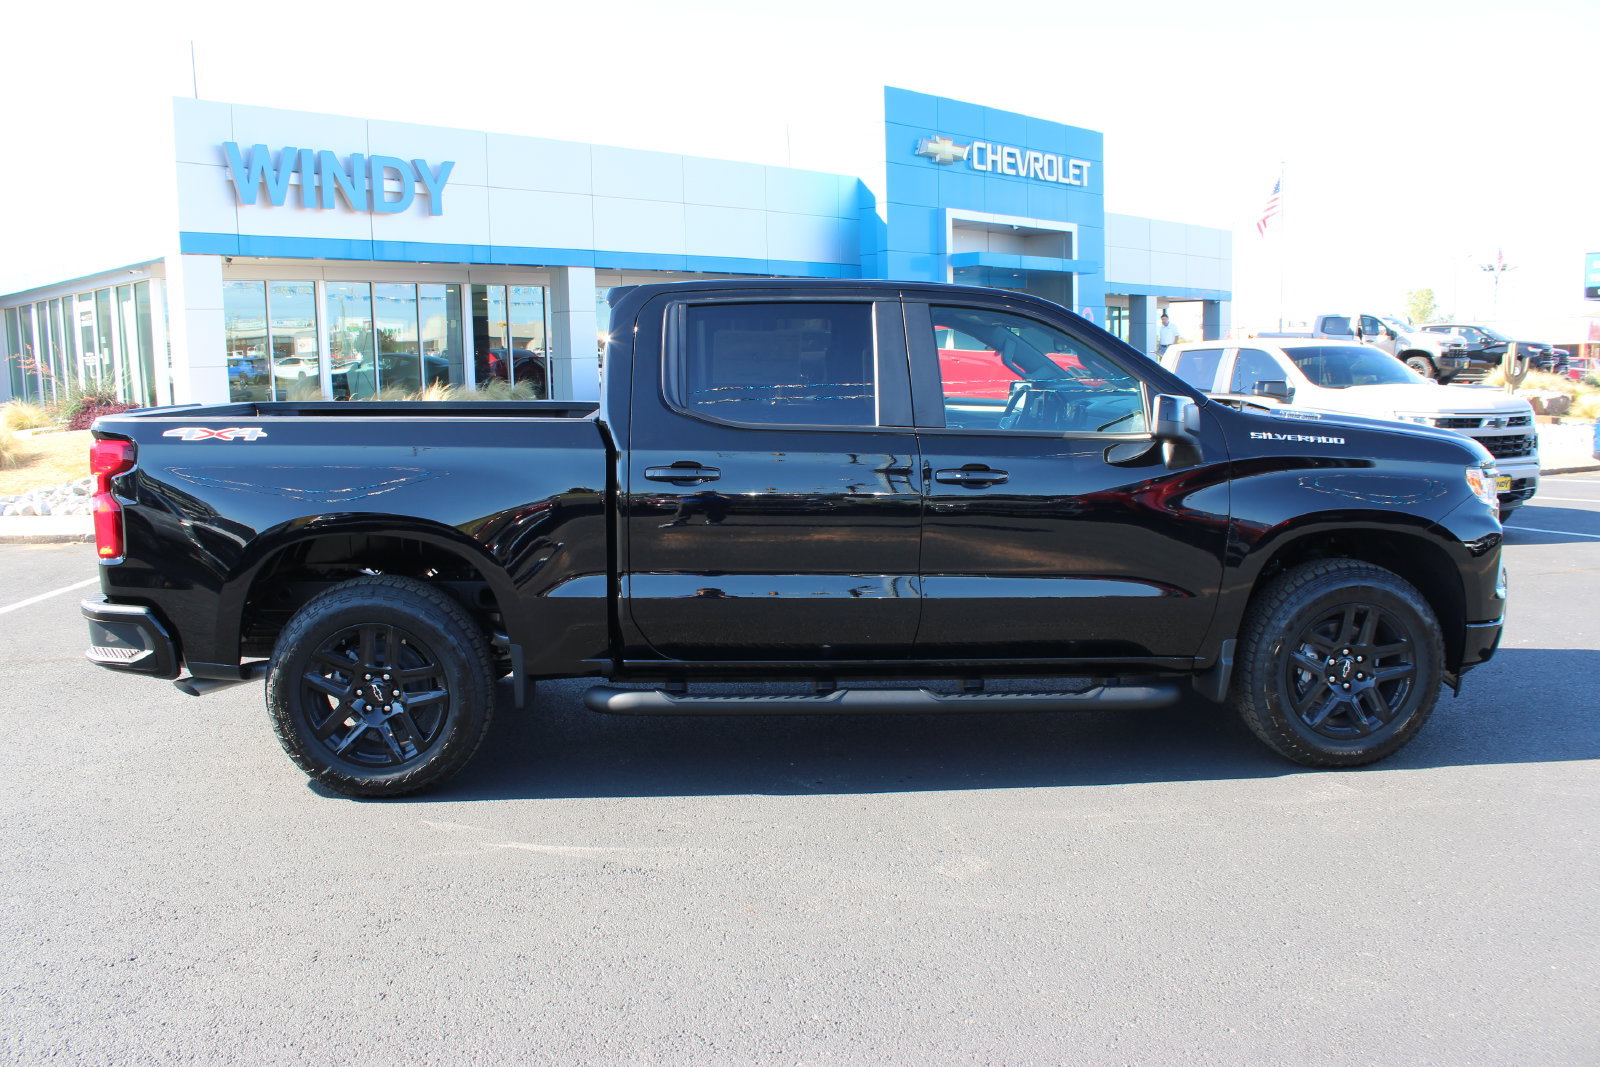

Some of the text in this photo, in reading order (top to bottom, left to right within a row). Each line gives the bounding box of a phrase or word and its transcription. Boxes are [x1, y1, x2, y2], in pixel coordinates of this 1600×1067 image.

[222, 141, 456, 217] WINDY
[972, 141, 1091, 187] CHEVROLET
[1249, 431, 1345, 445] SILVERADO
